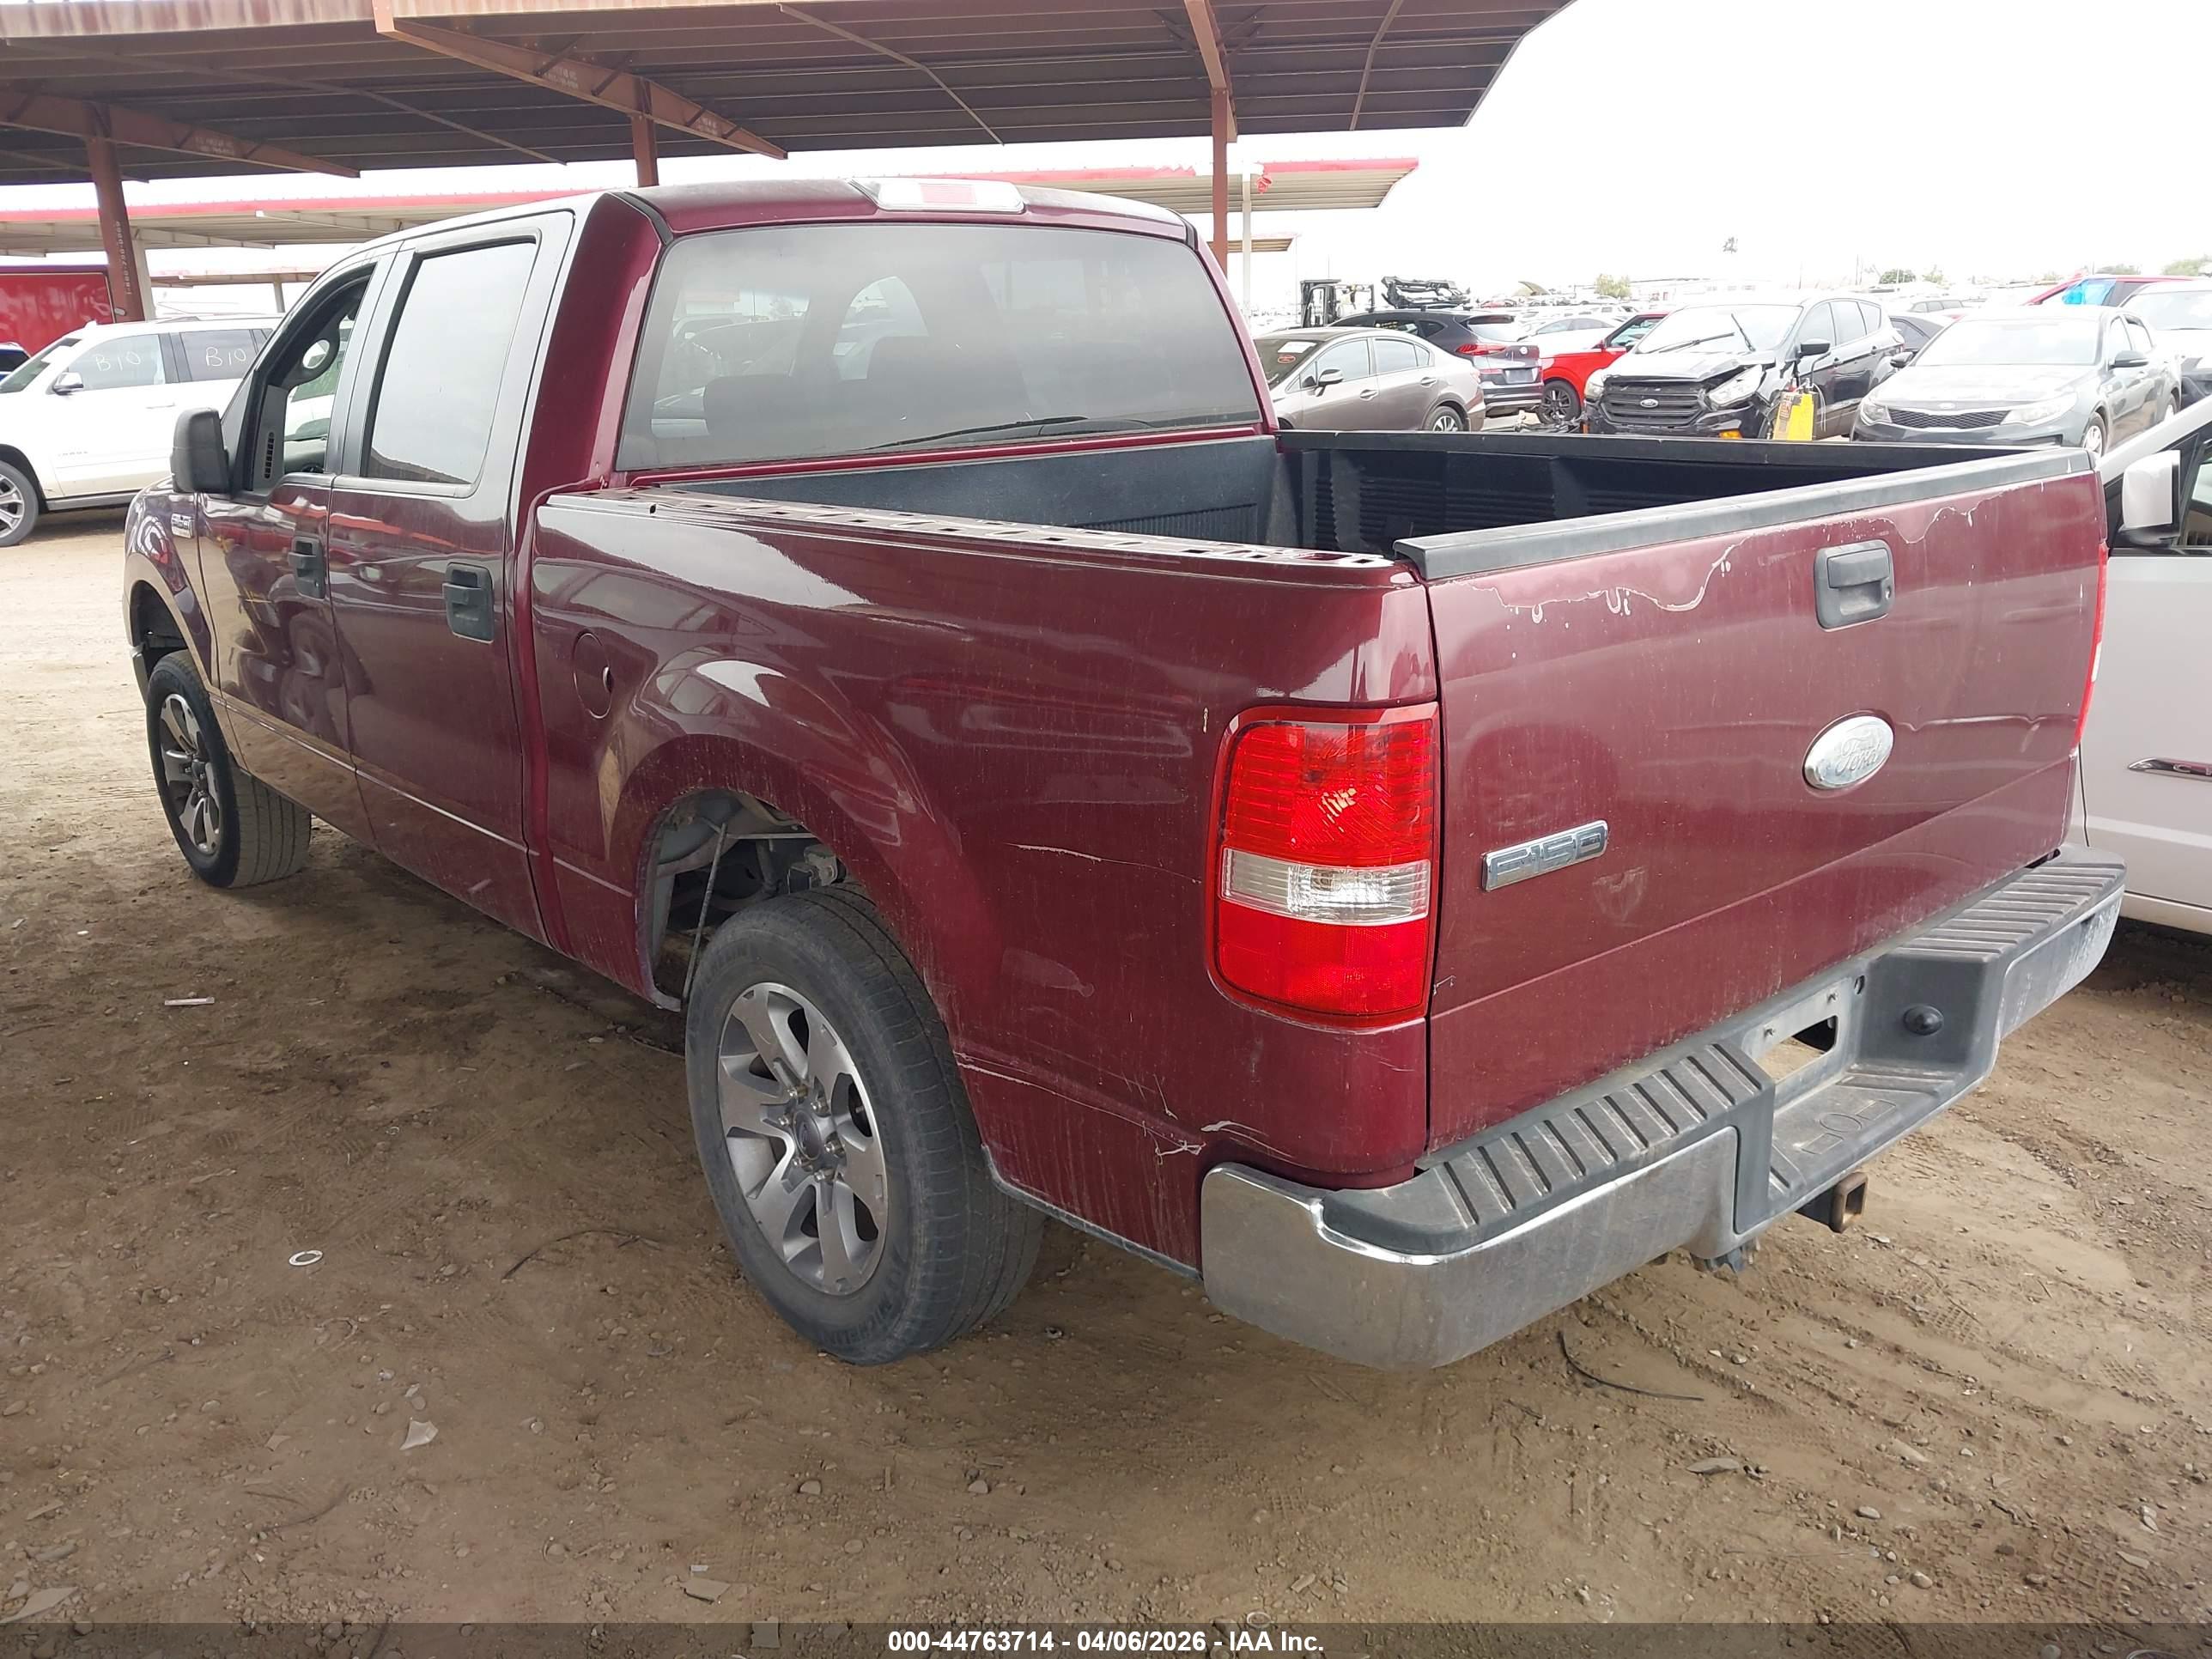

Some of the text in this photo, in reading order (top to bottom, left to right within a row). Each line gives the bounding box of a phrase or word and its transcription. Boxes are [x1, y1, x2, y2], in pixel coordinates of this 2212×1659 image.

[94, 351, 142, 372] B10
[205, 346, 246, 367] B10
[1834, 727, 1883, 777] Ford
